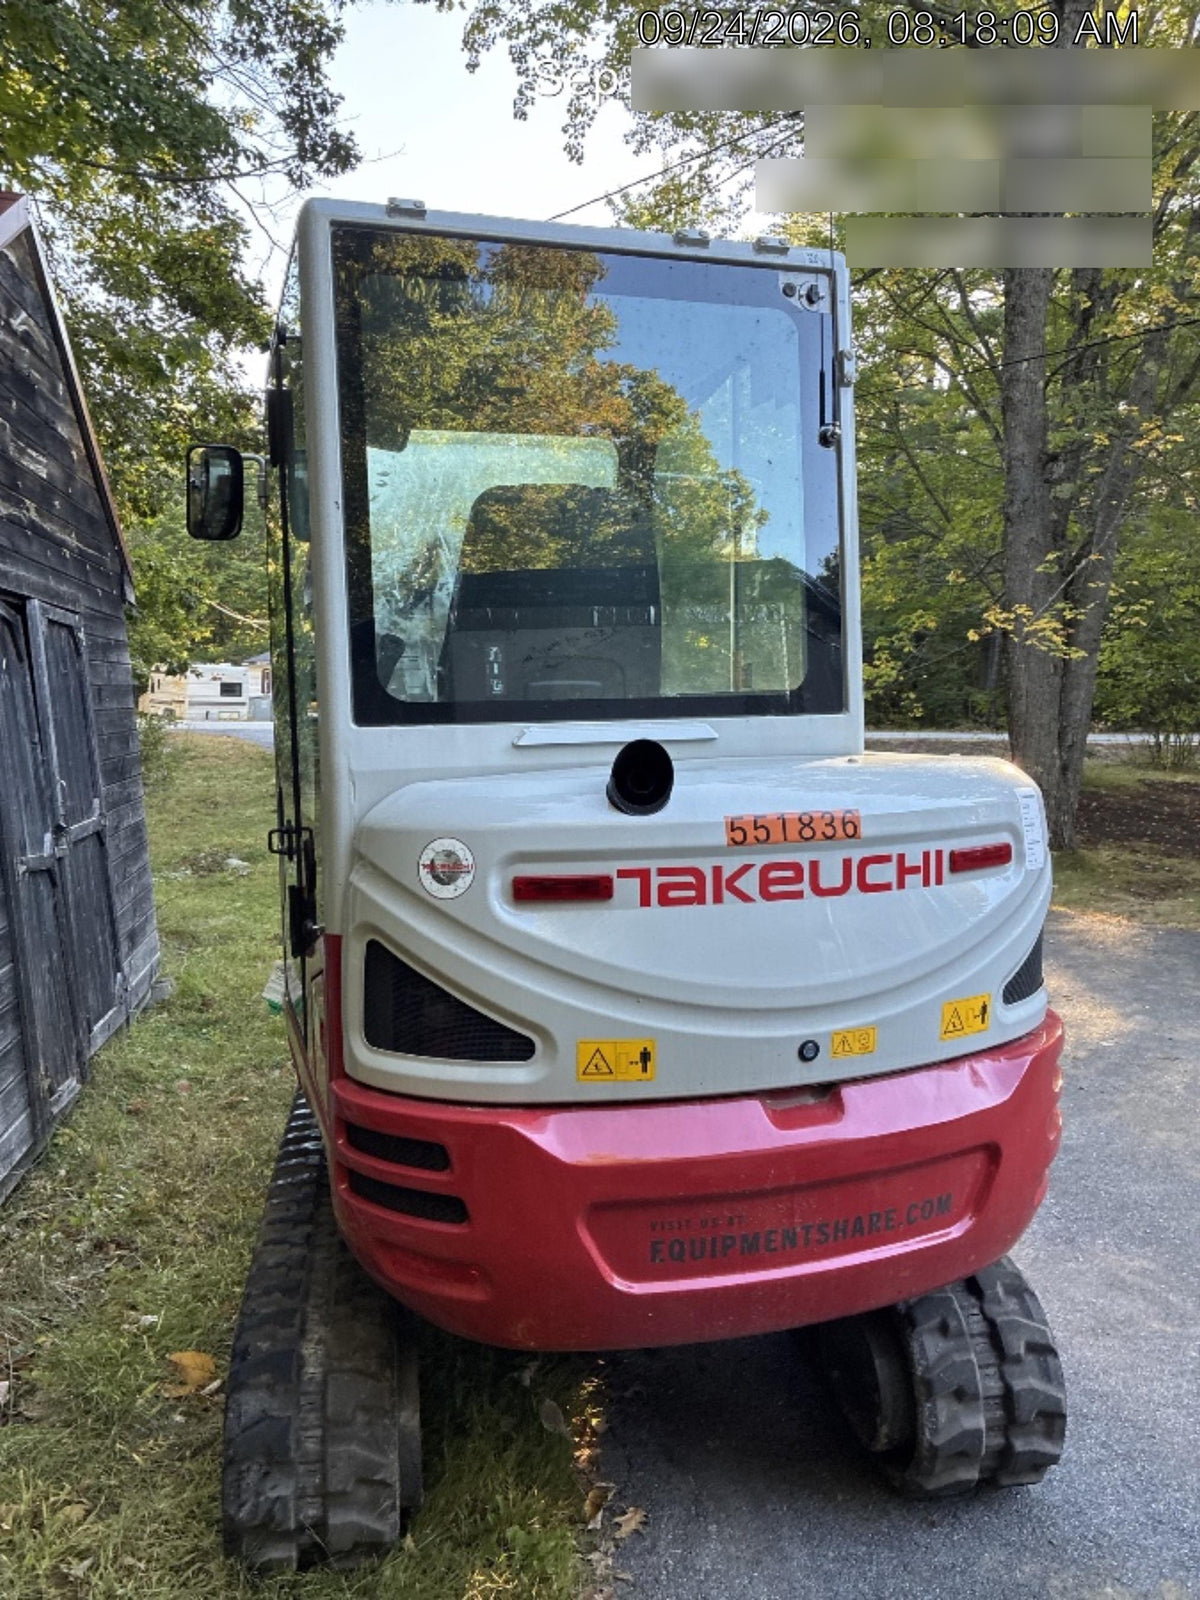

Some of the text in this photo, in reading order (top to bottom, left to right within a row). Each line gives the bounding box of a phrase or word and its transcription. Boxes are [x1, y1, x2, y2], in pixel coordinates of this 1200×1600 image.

[728, 810, 859, 845] 551836
[649, 1194, 952, 1264] EQUIPMENTSHARE.COM
[650, 1218, 691, 1232] VISIT
[700, 1216, 720, 1229] US
